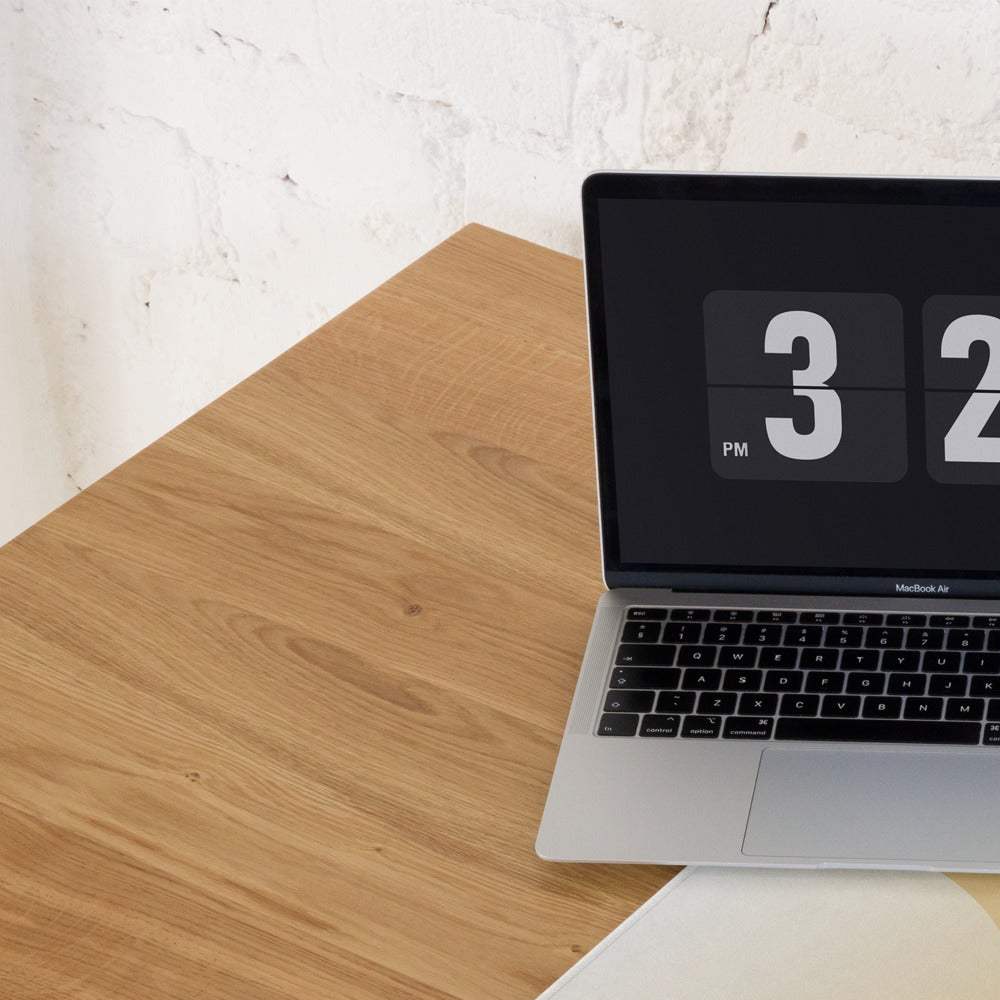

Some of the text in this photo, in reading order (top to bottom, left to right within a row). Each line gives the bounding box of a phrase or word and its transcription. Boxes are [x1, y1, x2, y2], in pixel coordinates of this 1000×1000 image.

[764, 310, 842, 461] 3
[722, 441, 749, 457] PM
[895, 583, 951, 593] MacBook Air
[692, 652, 702, 660] Q
[732, 653, 744, 661] W
[938, 658, 947, 666] U
[697, 675, 706, 683] A
[738, 676, 747, 684] S
[779, 677, 788, 685] D
[713, 699, 722, 707] Z
[754, 700, 763, 708] X
[796, 701, 805, 709] C
[837, 702, 846, 710] V
